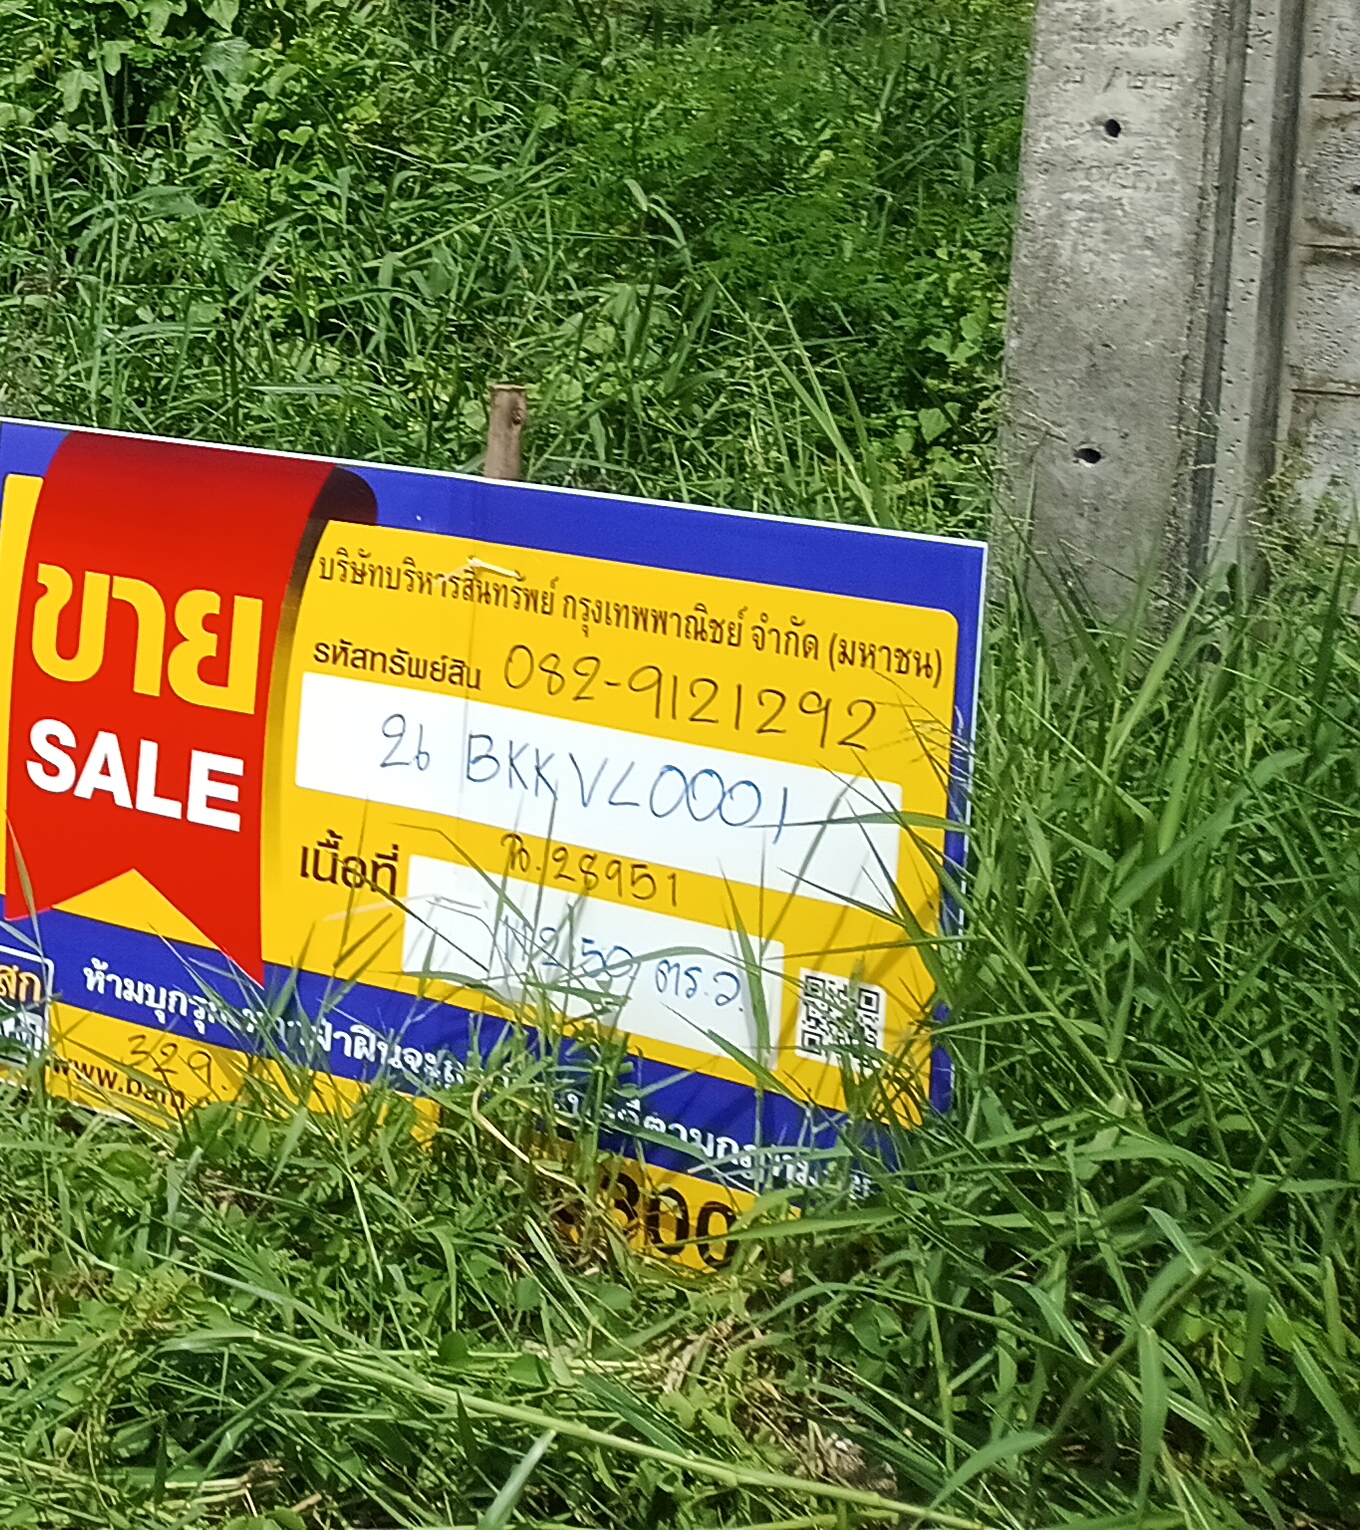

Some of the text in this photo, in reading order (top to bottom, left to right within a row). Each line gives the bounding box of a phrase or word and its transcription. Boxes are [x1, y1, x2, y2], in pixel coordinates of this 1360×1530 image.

[31, 562, 263, 715] ขาย
[312, 638, 482, 691] รหัสทรัพย์สิน
[563, 594, 747, 649] กรุงเทพพาณิชย์
[751, 612, 820, 661] จำกัด
[828, 632, 942, 689] (มหาชน)
[503, 644, 877, 751] 082-9121292
[25, 718, 245, 832] SALE
[300, 828, 399, 896] เนื้อที่
